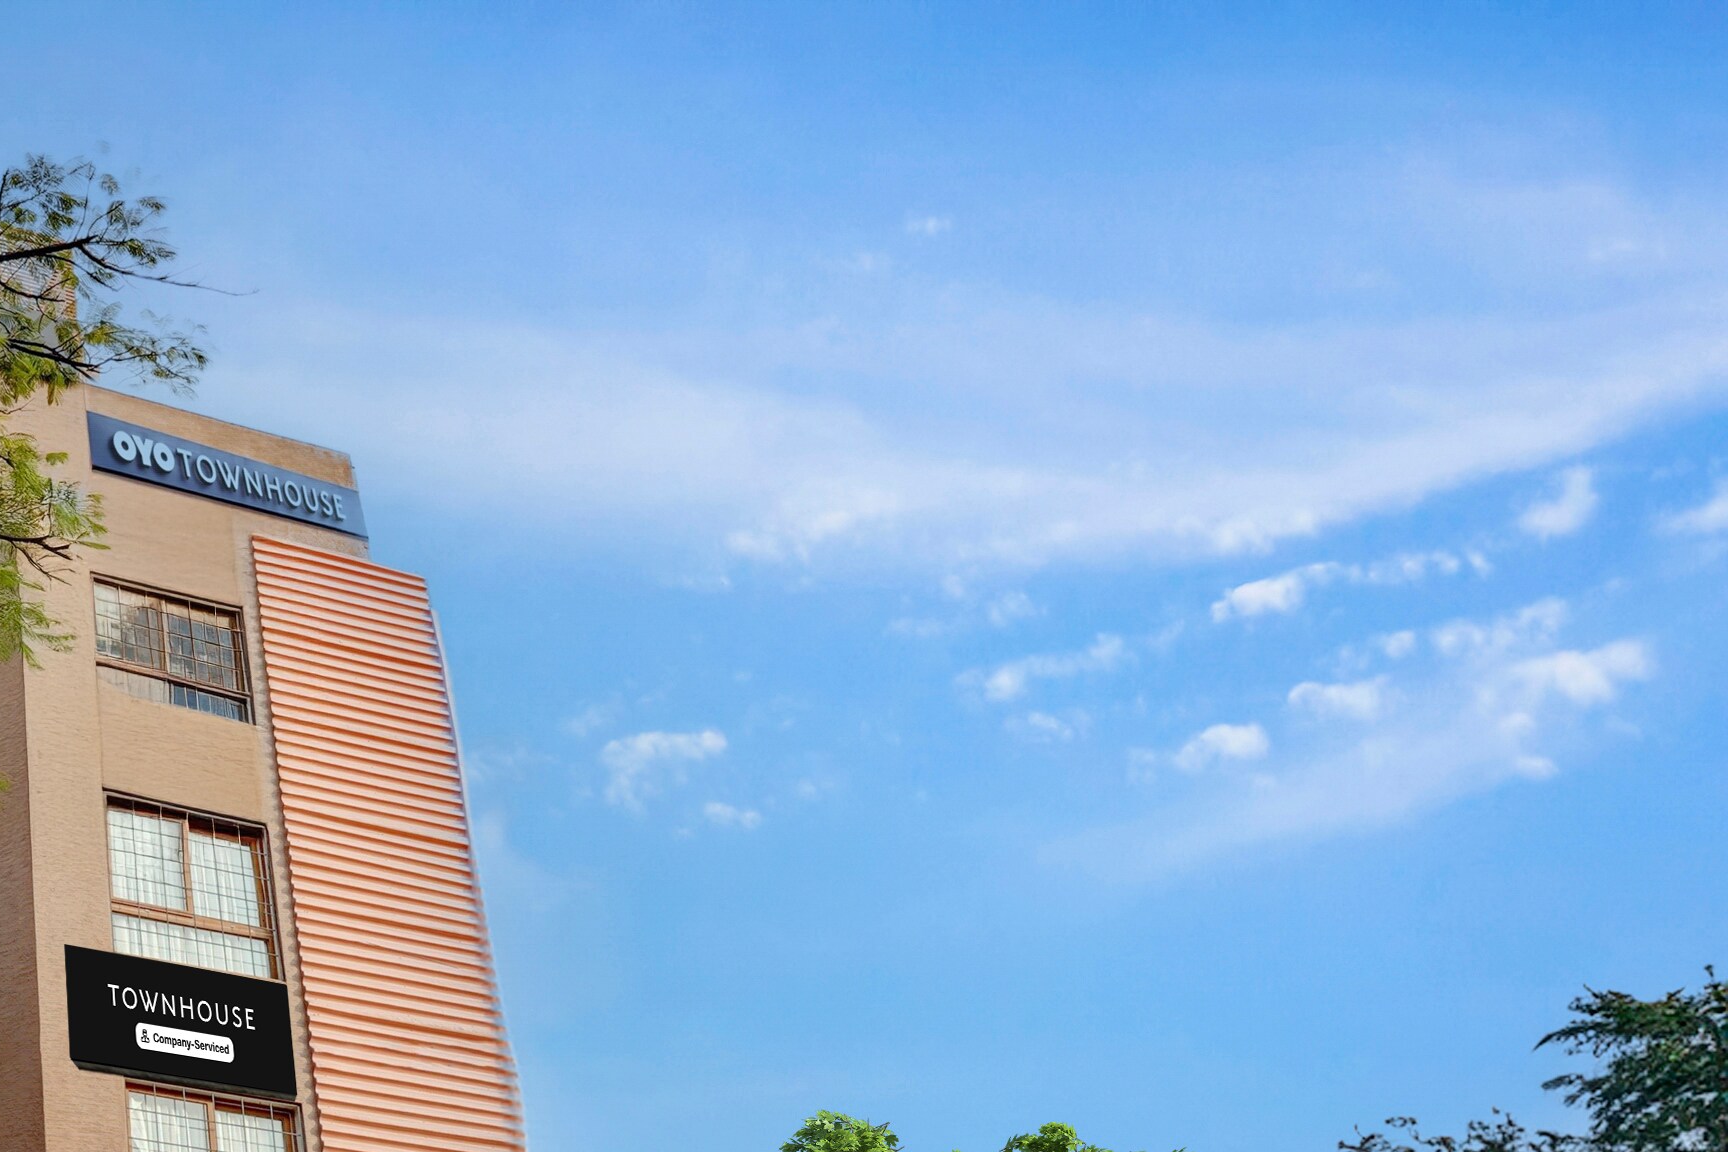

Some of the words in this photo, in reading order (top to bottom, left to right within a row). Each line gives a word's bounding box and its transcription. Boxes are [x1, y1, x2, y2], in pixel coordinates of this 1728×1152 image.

[112, 430, 175, 473] OYO
[176, 447, 346, 520] TOWNHOUSE
[107, 983, 256, 1031] TOWNHOUSE
[153, 1033, 230, 1055] Company-Serviced
